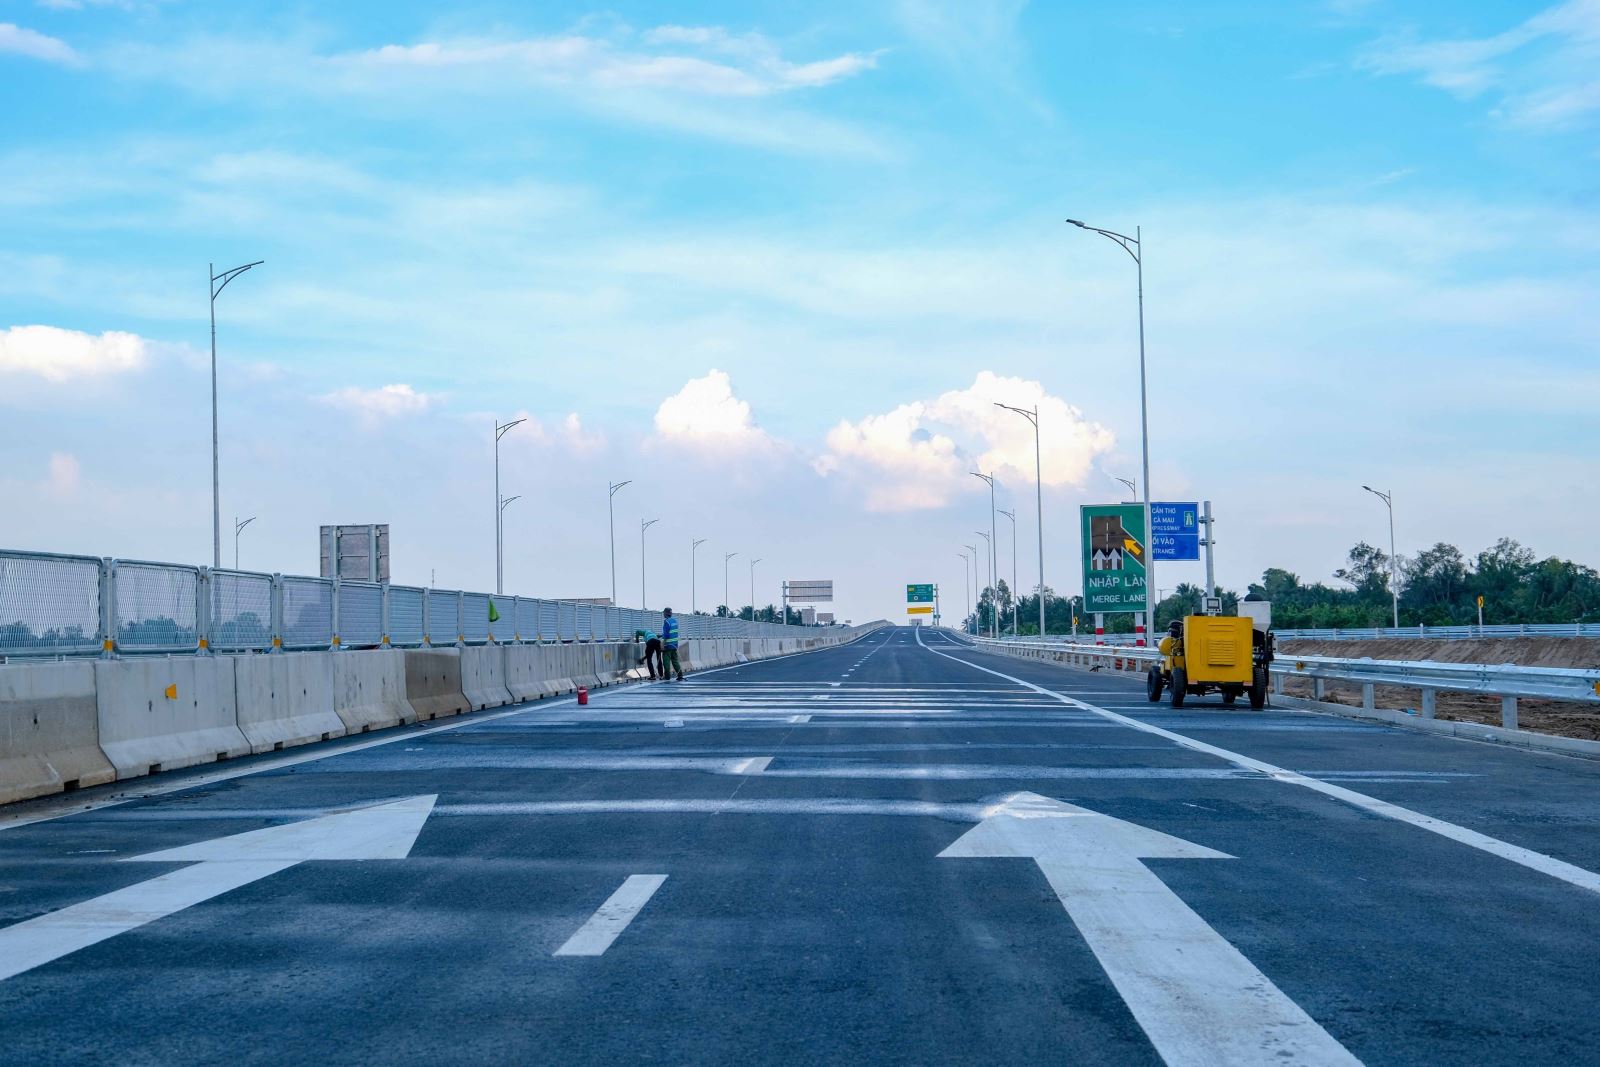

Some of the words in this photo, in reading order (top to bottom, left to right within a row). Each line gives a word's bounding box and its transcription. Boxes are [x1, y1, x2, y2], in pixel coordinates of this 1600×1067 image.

[1160, 536, 1175, 545] VÀO
[1089, 574, 1120, 589] NHẬP
[1124, 574, 1147, 587] LÀN
[1092, 594, 1120, 603] MERGE
[1123, 594, 1146, 603] LANE
